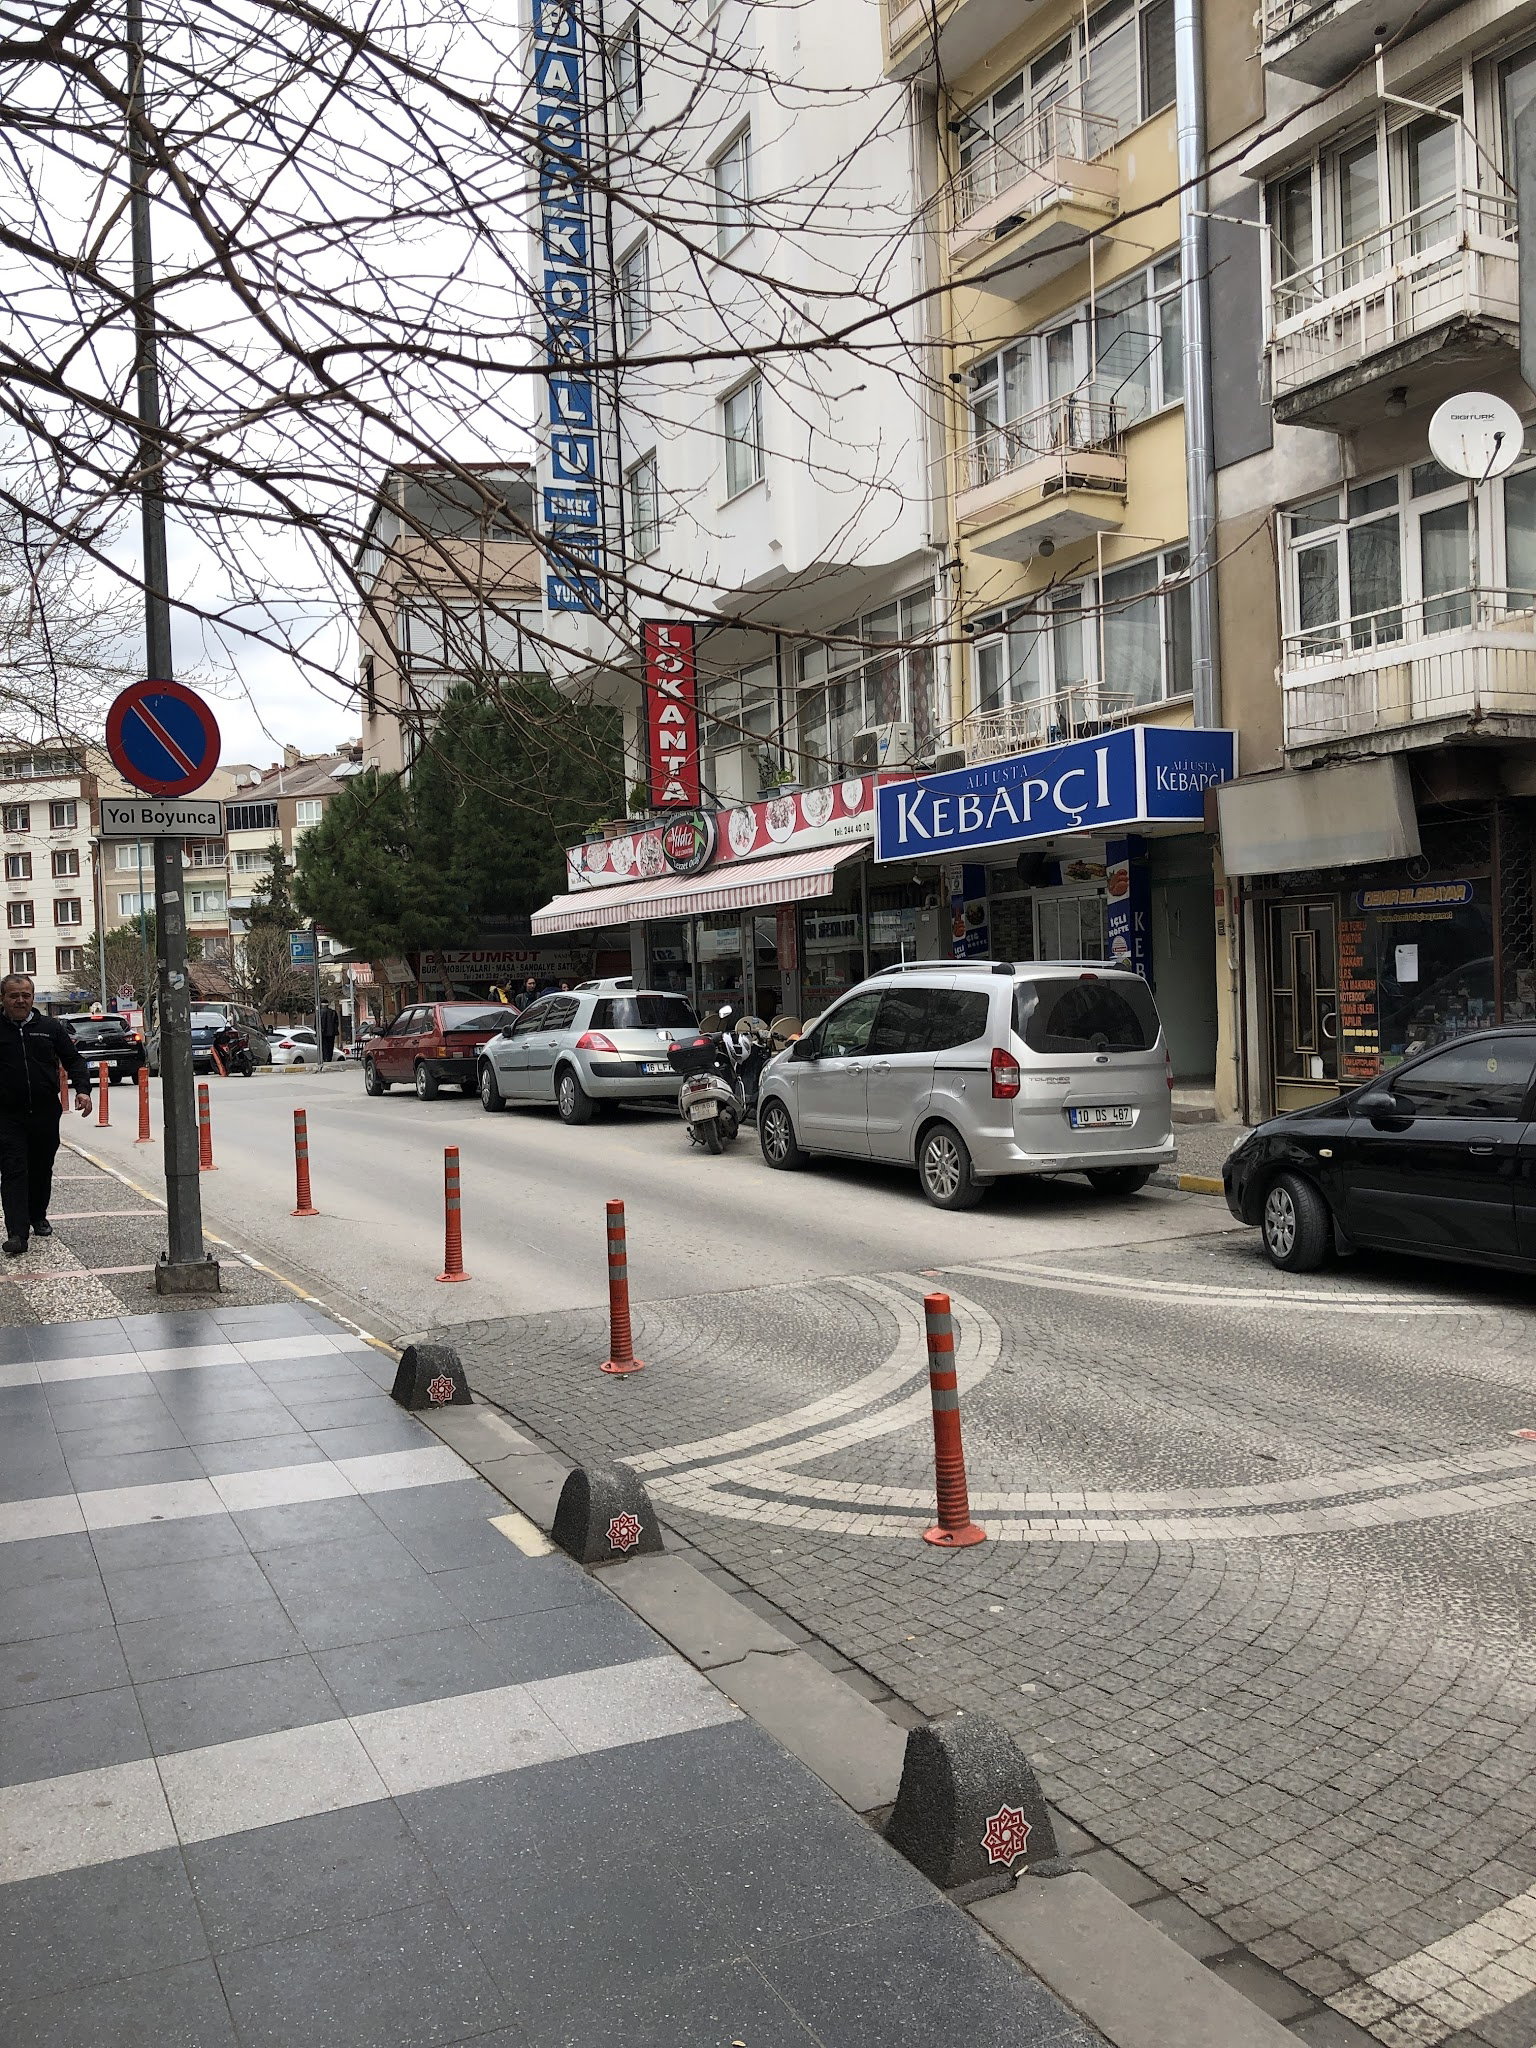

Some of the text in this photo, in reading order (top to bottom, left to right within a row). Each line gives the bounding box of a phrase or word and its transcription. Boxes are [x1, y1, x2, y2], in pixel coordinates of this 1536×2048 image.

[1451, 413, 1495, 421] DIGITURK
[551, 496, 591, 517] ERKEK
[655, 627, 689, 801] LOKANTA
[992, 764, 1028, 784] USTA
[1190, 761, 1216, 771] USTA
[896, 747, 1111, 844] KEBAPÇI
[108, 808, 216, 828] Yol Boyunca
[844, 825, 854, 835] 244
[855, 824, 862, 833] 40
[863, 822, 870, 831] 10
[496, 964, 515, 973] MASA
[519, 962, 555, 972] SANDALYE
[1078, 1108, 1129, 1122] 10 DS 487
